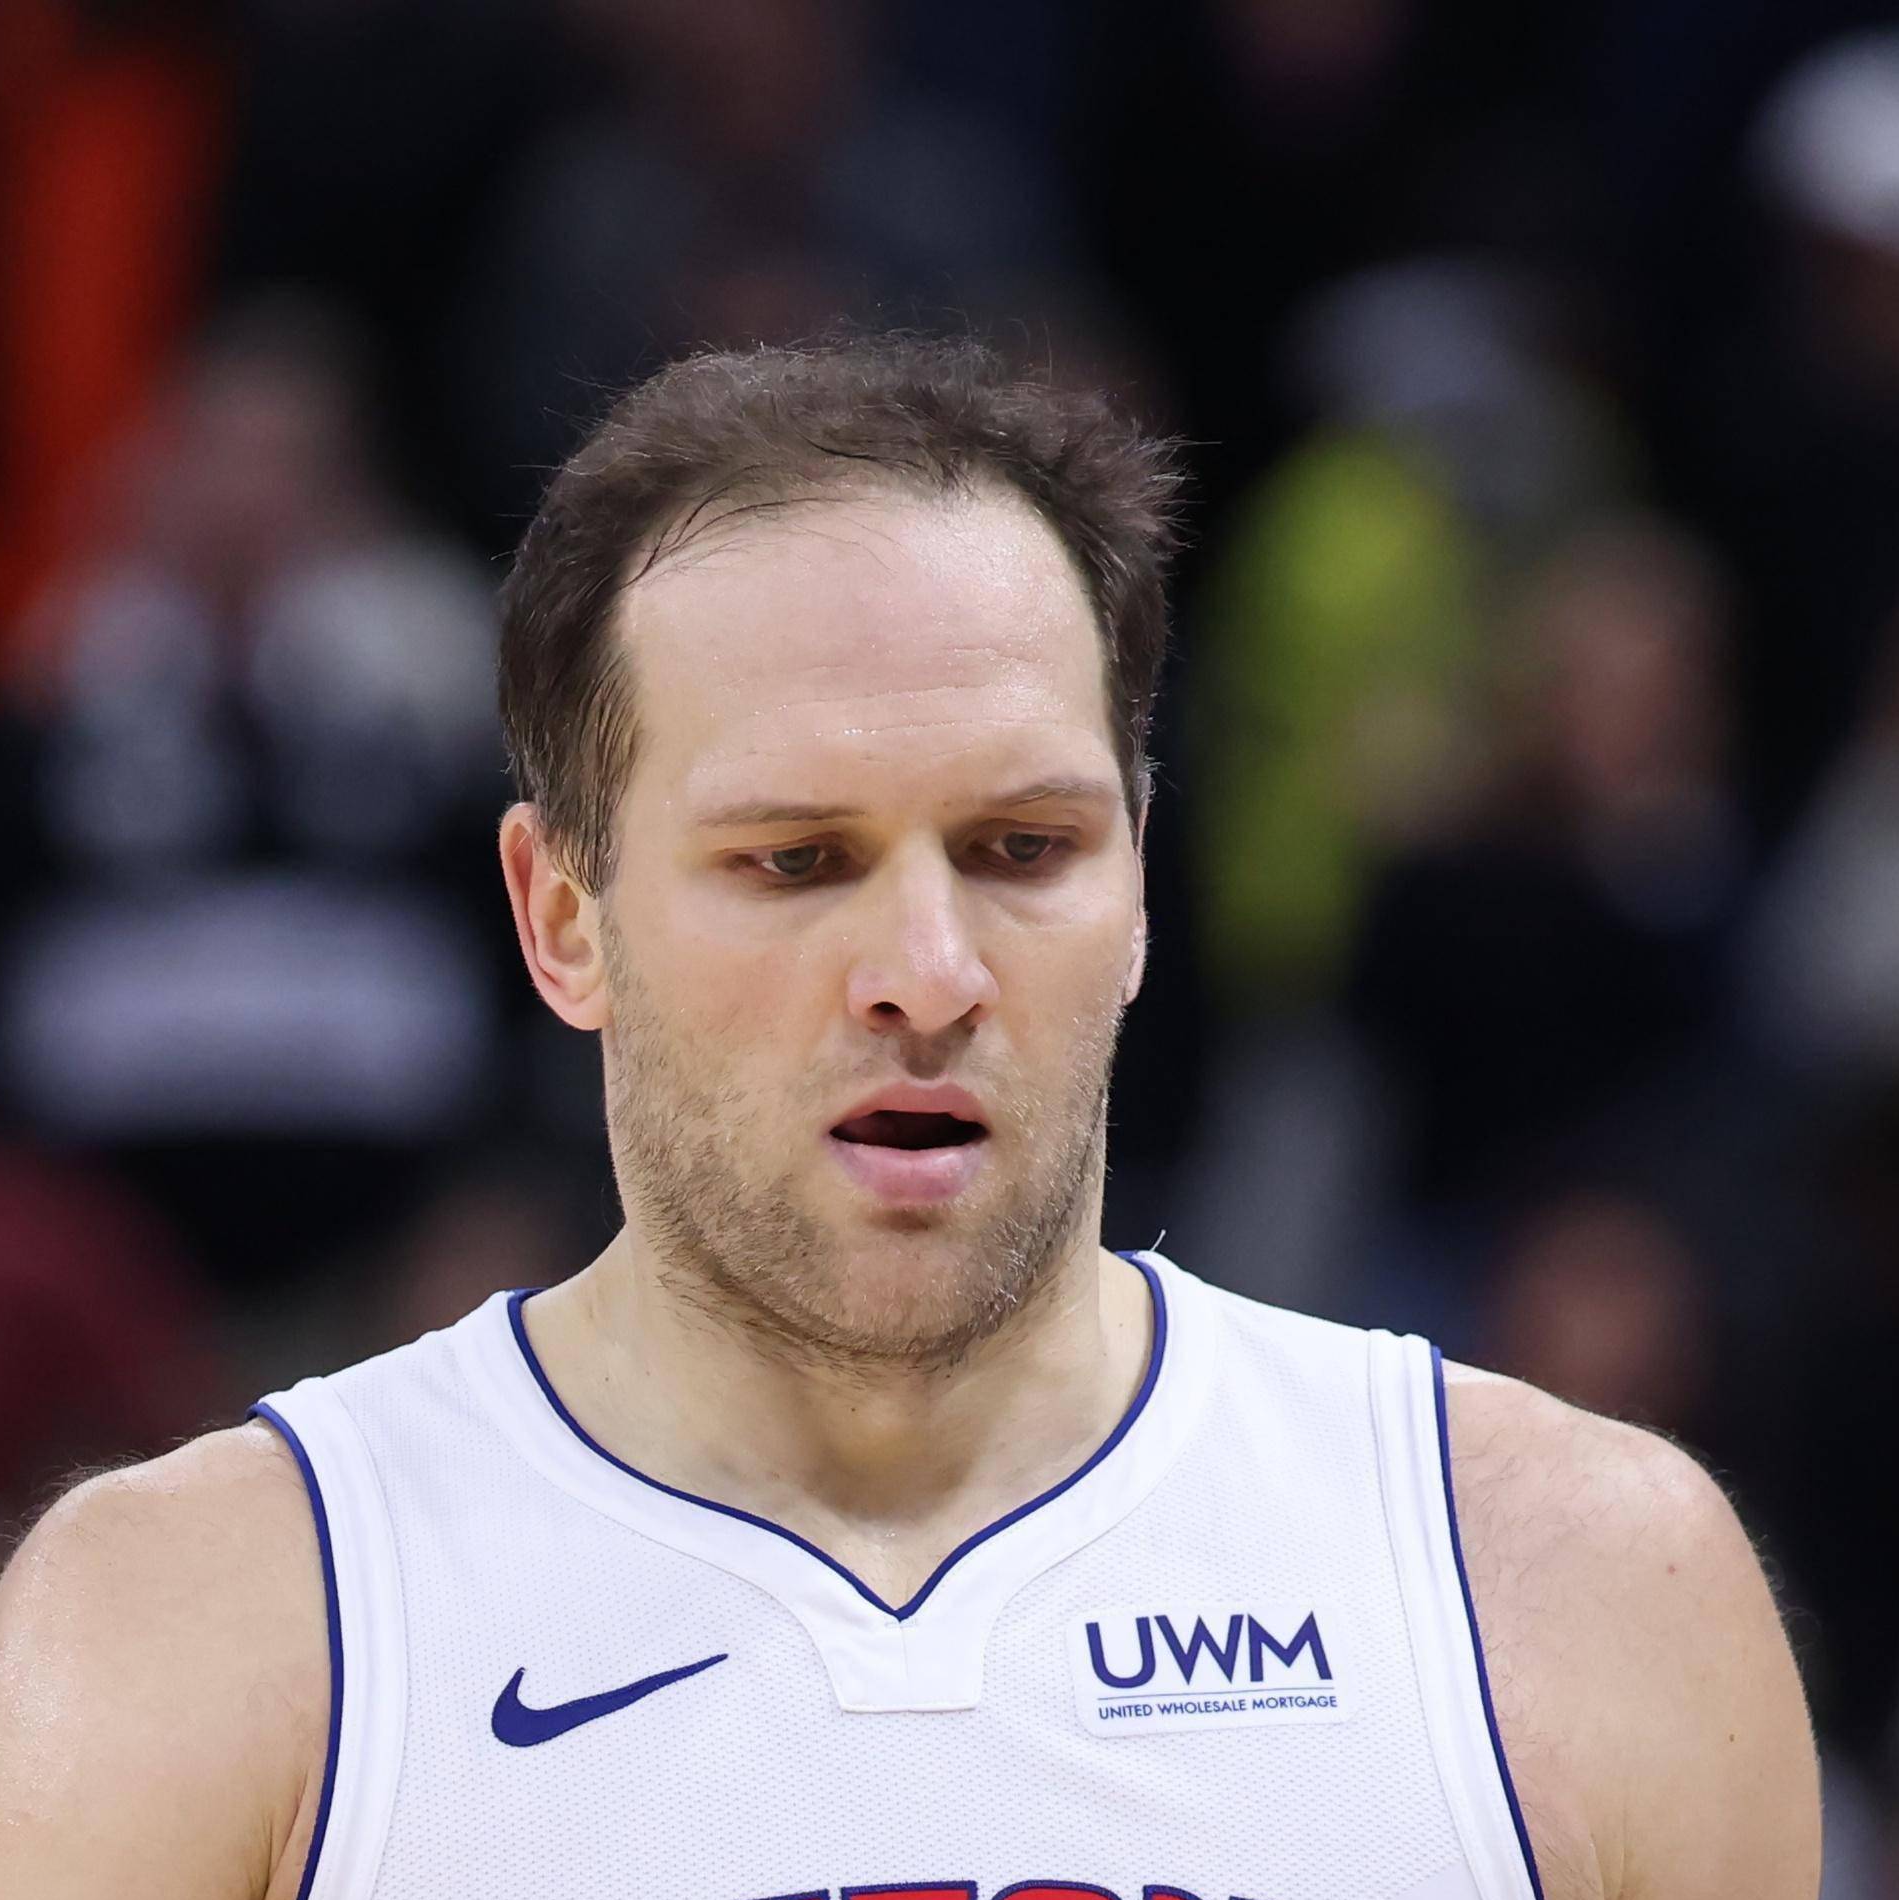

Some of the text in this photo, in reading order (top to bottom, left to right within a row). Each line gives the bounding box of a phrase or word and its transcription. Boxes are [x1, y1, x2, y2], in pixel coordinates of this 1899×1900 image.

[1085, 1611, 1333, 1688] UWM
[1098, 1695, 1338, 1721] UNITED WHOLESALE MORTGAGE
